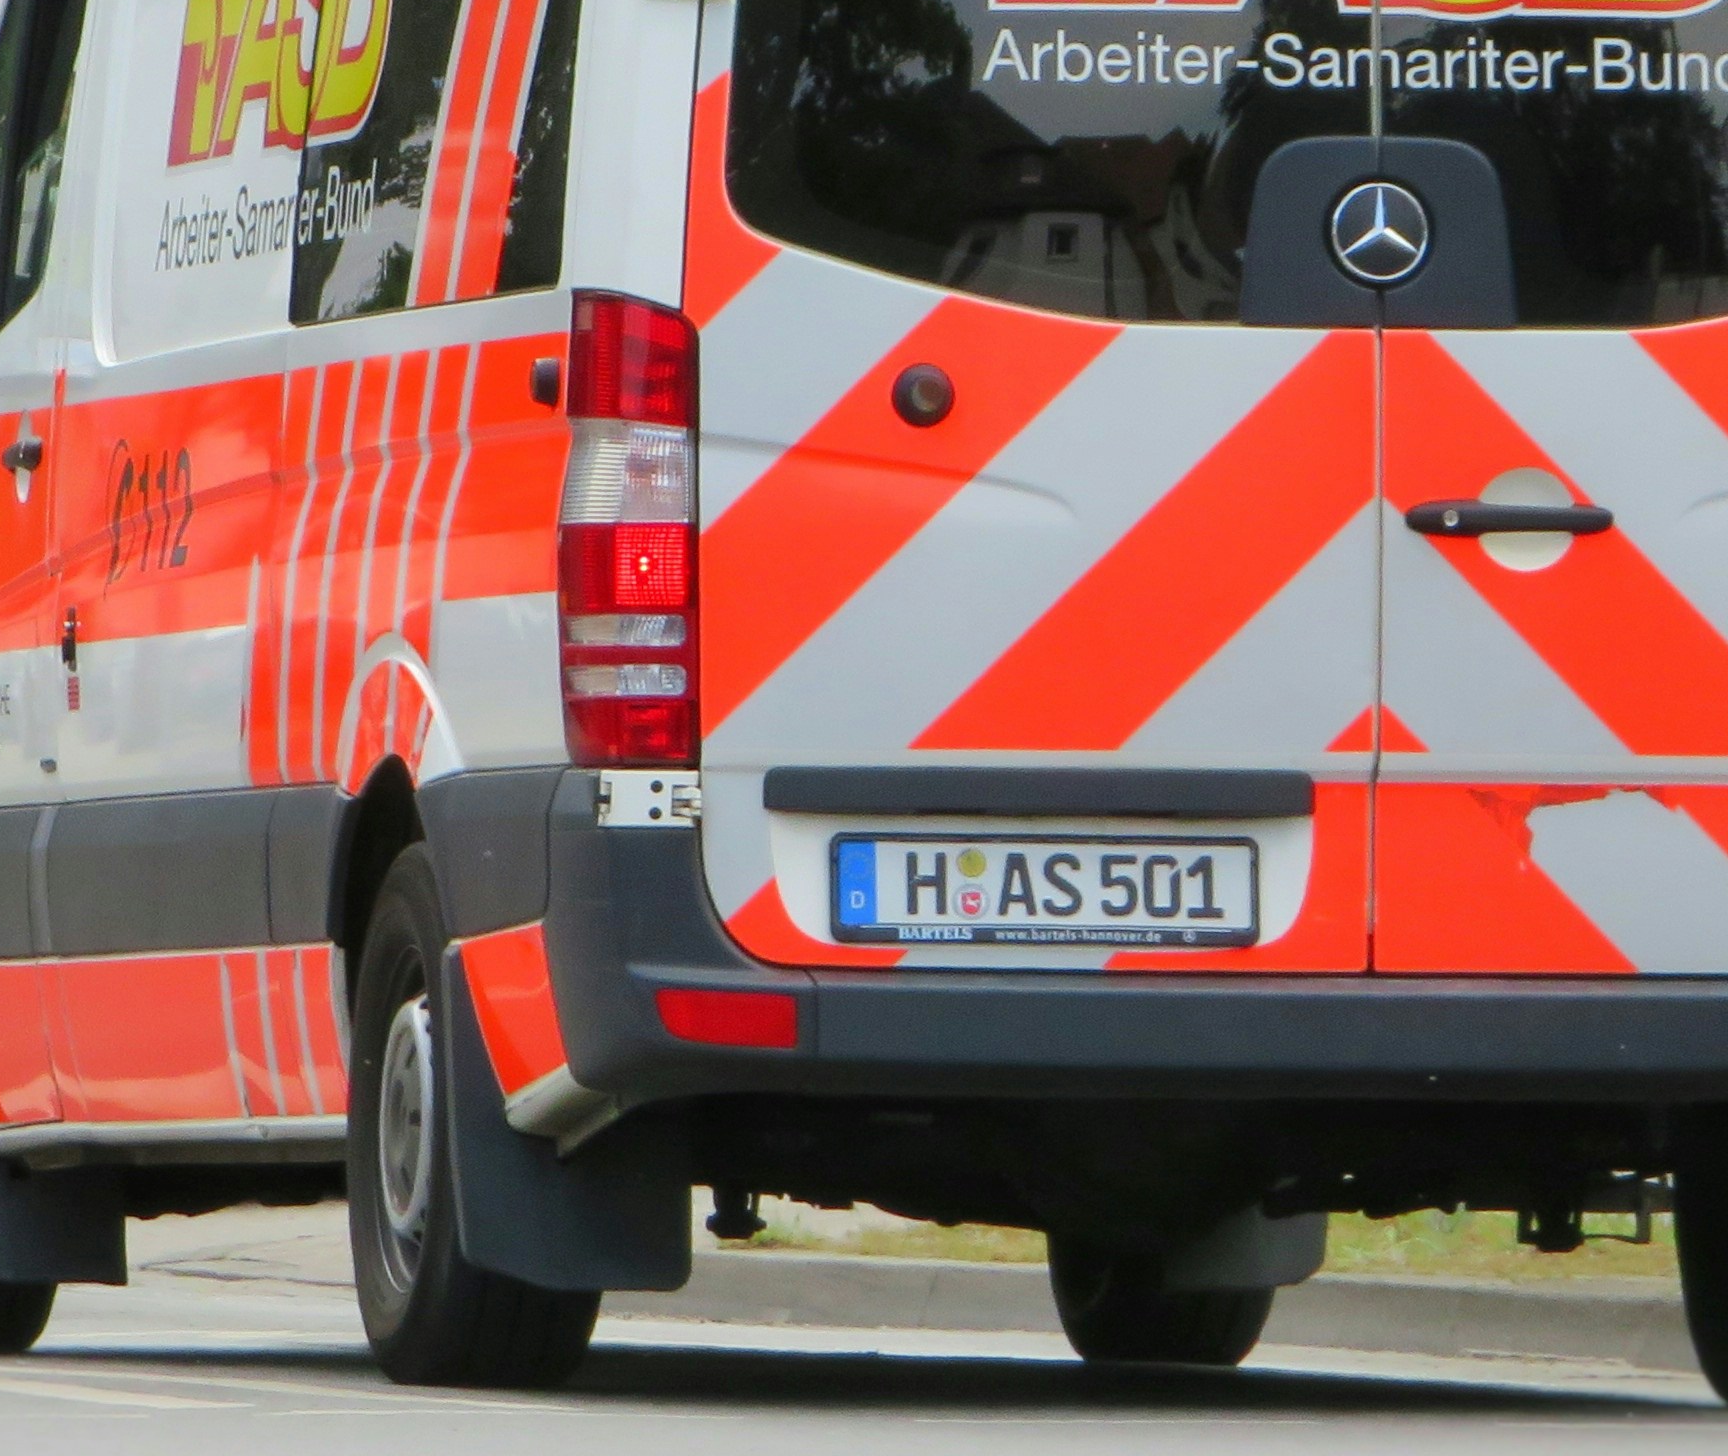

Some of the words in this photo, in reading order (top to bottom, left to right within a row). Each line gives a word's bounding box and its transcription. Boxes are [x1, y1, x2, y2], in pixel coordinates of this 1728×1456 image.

[138, 447, 194, 573] 112
[850, 890, 866, 909] D
[906, 851, 948, 916] H
[998, 852, 1083, 917] AS
[1100, 853, 1225, 920] 501
[898, 926, 973, 941] BARTELS
[995, 926, 1162, 944] www.bartels-hannover.de
